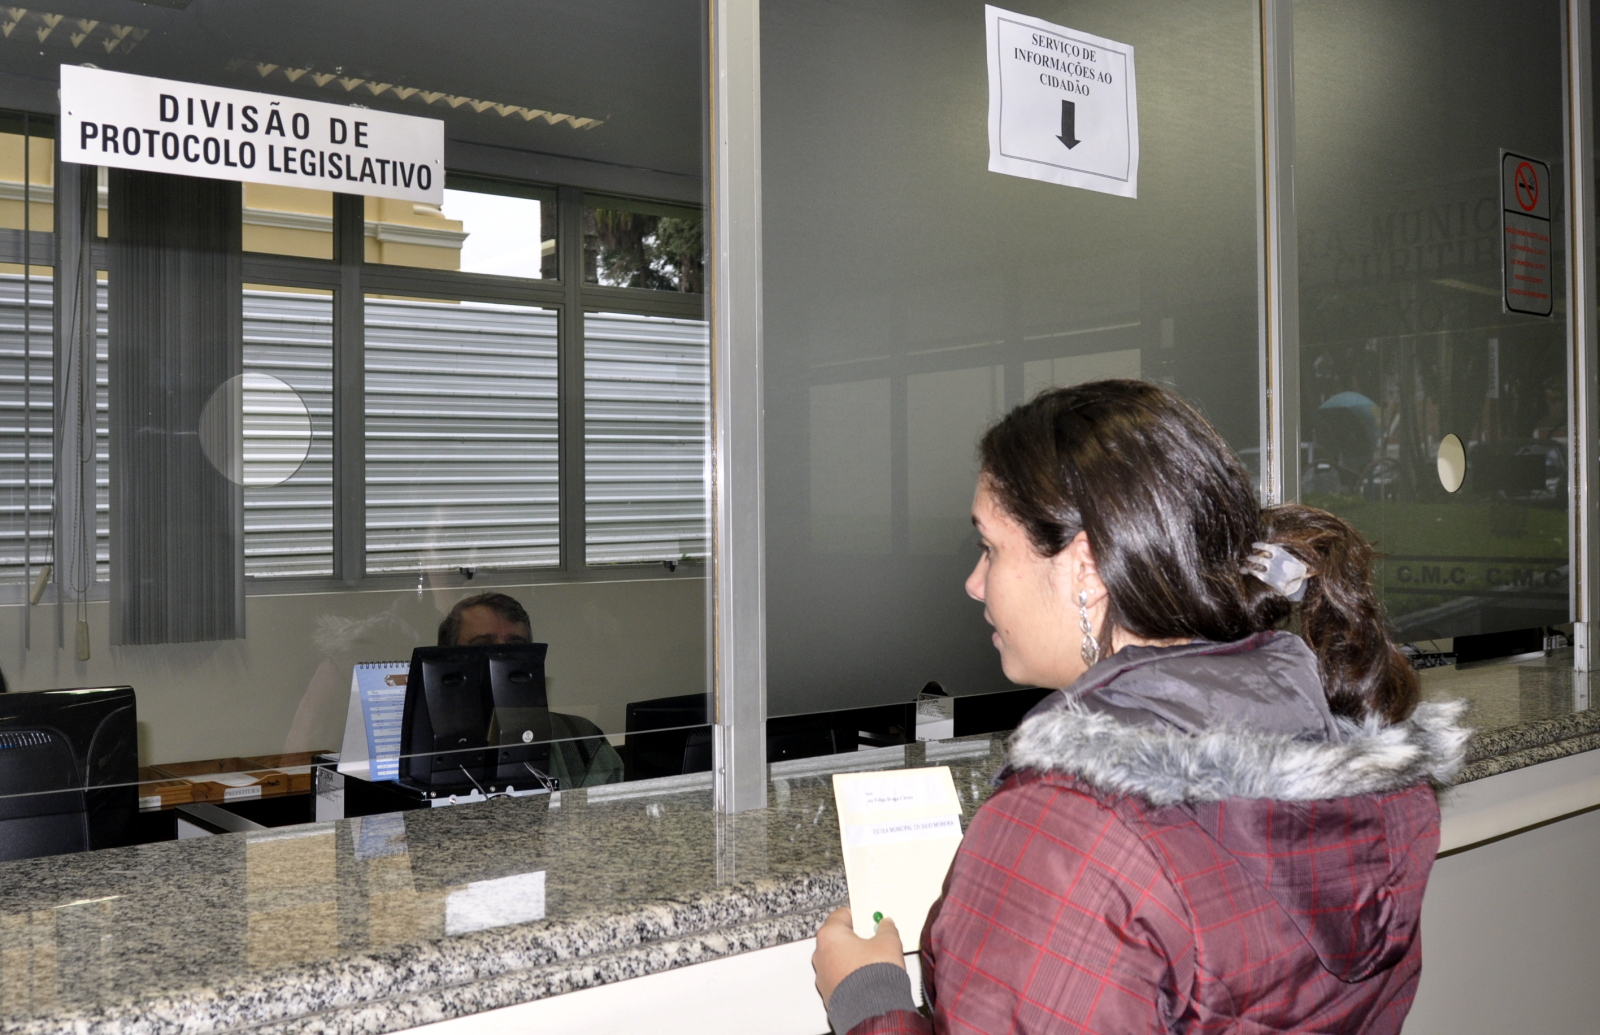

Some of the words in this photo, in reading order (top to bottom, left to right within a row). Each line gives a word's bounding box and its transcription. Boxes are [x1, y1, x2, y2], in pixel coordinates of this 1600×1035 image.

[1031, 33, 1080, 58] SERVIÇO
[1082, 47, 1097, 63] DE
[1014, 47, 1096, 81] INFORMAÇÕES
[1096, 71, 1113, 85] AO
[1039, 72, 1090, 97] CIDADÃO
[159, 93, 310, 140] DIVISÃO
[329, 117, 369, 149] DE
[80, 120, 256, 170] PROTOCOLO
[268, 143, 432, 191] LEGISLATIVO
[1396, 565, 1466, 585] C.M.C
[225, 786, 261, 797] PREFEITURA
[872, 827, 889, 835] ESCOLA
[889, 824, 912, 833] MUNICIPAL
[933, 820, 954, 829] MOREIRA
